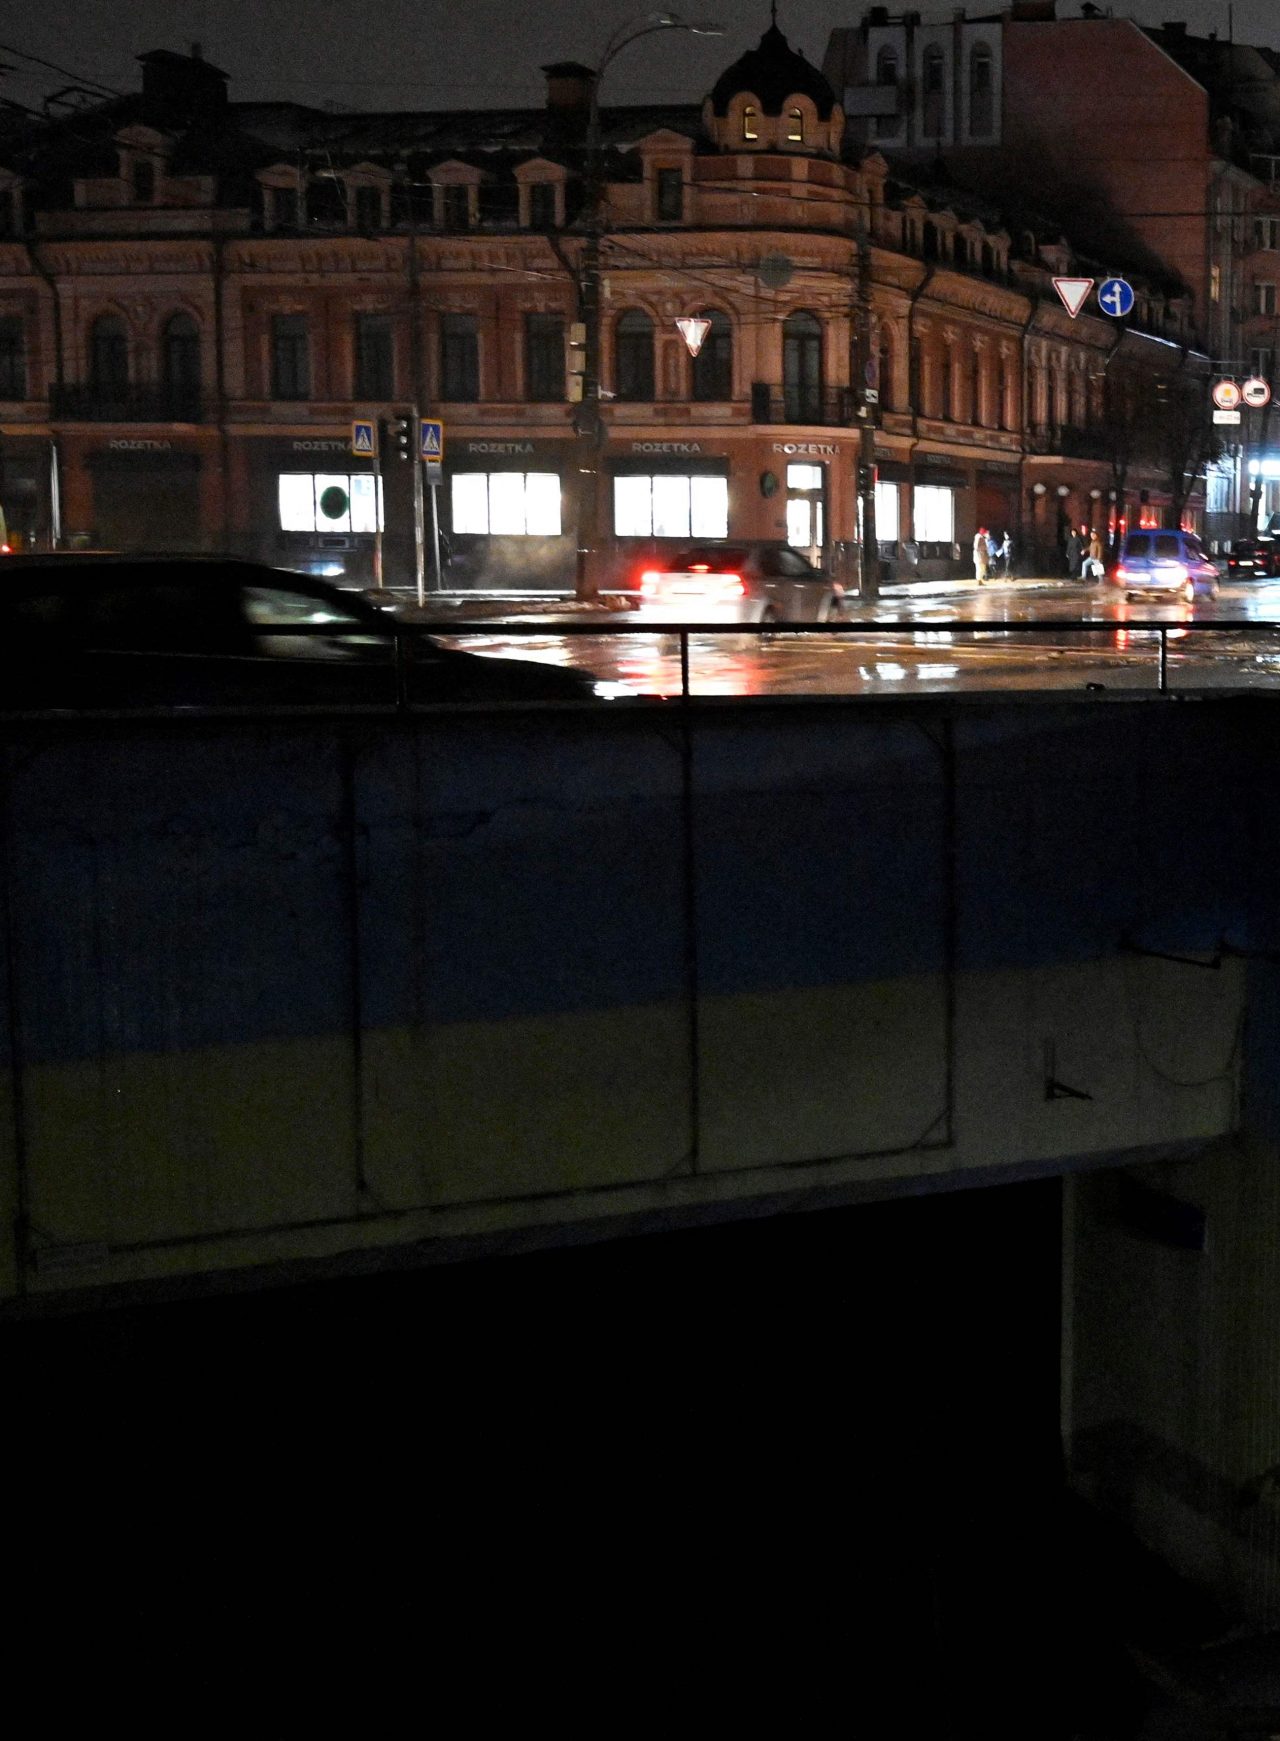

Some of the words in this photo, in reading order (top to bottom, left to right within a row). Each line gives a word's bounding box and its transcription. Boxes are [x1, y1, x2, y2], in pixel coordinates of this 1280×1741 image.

[109, 440, 171, 450] ROZETKA
[469, 442, 534, 454] ROZETKA
[632, 442, 701, 454] ROZETKA
[773, 443, 841, 455] ROZETKA
